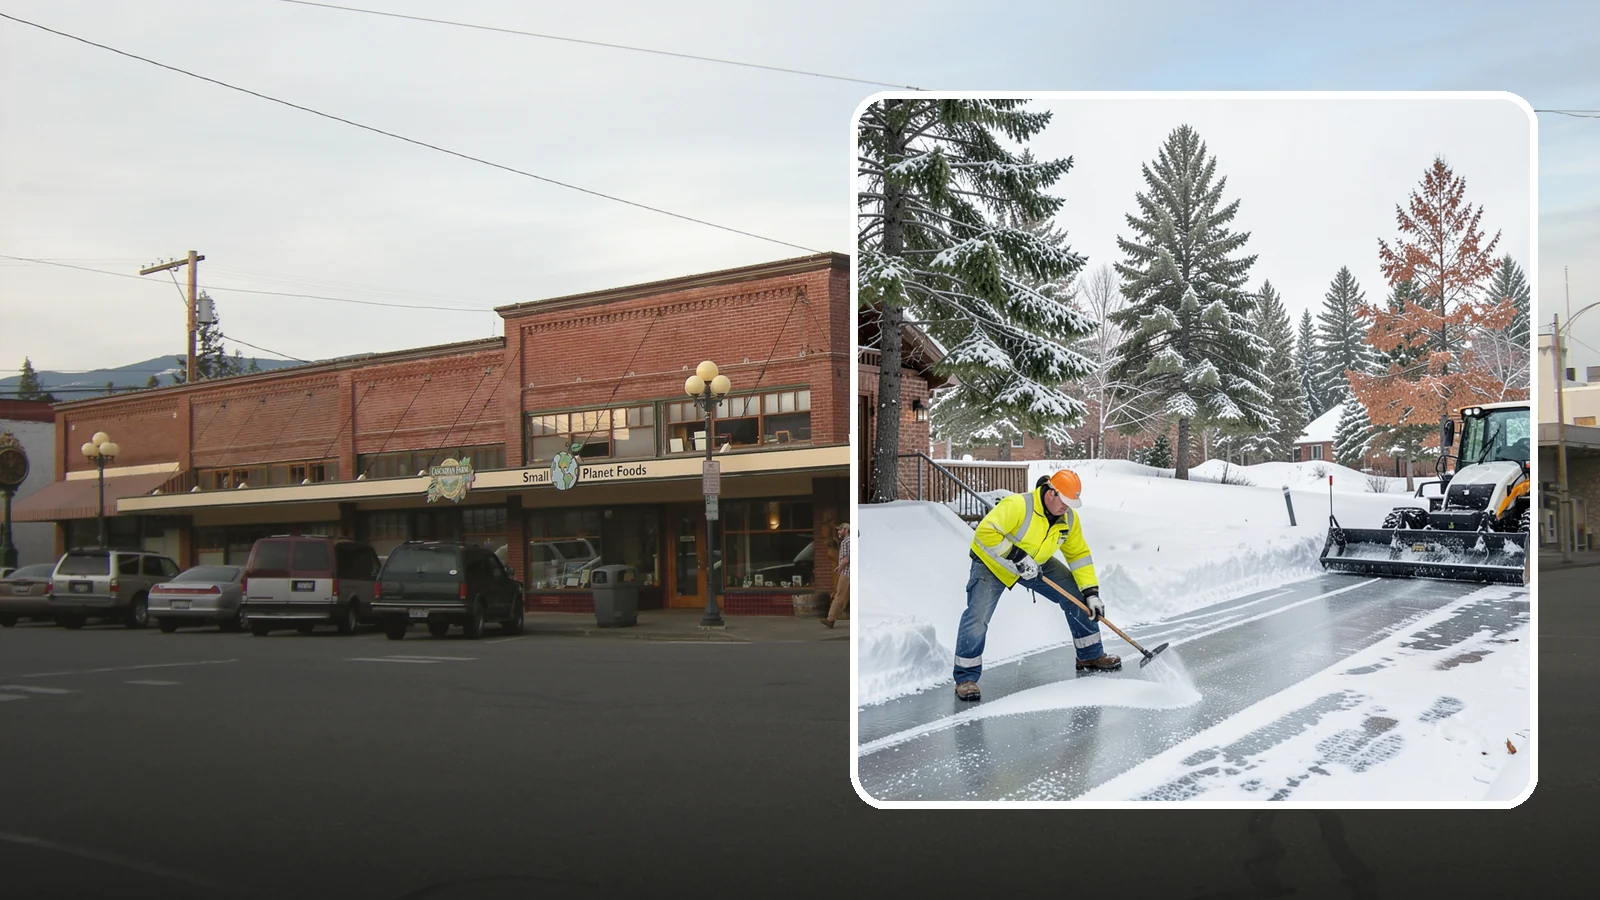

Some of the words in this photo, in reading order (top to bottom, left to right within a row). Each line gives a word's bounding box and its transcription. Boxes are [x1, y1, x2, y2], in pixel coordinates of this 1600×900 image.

[522, 470, 549, 483] Small
[582, 467, 614, 479] Planet
[616, 464, 647, 477] Foods
